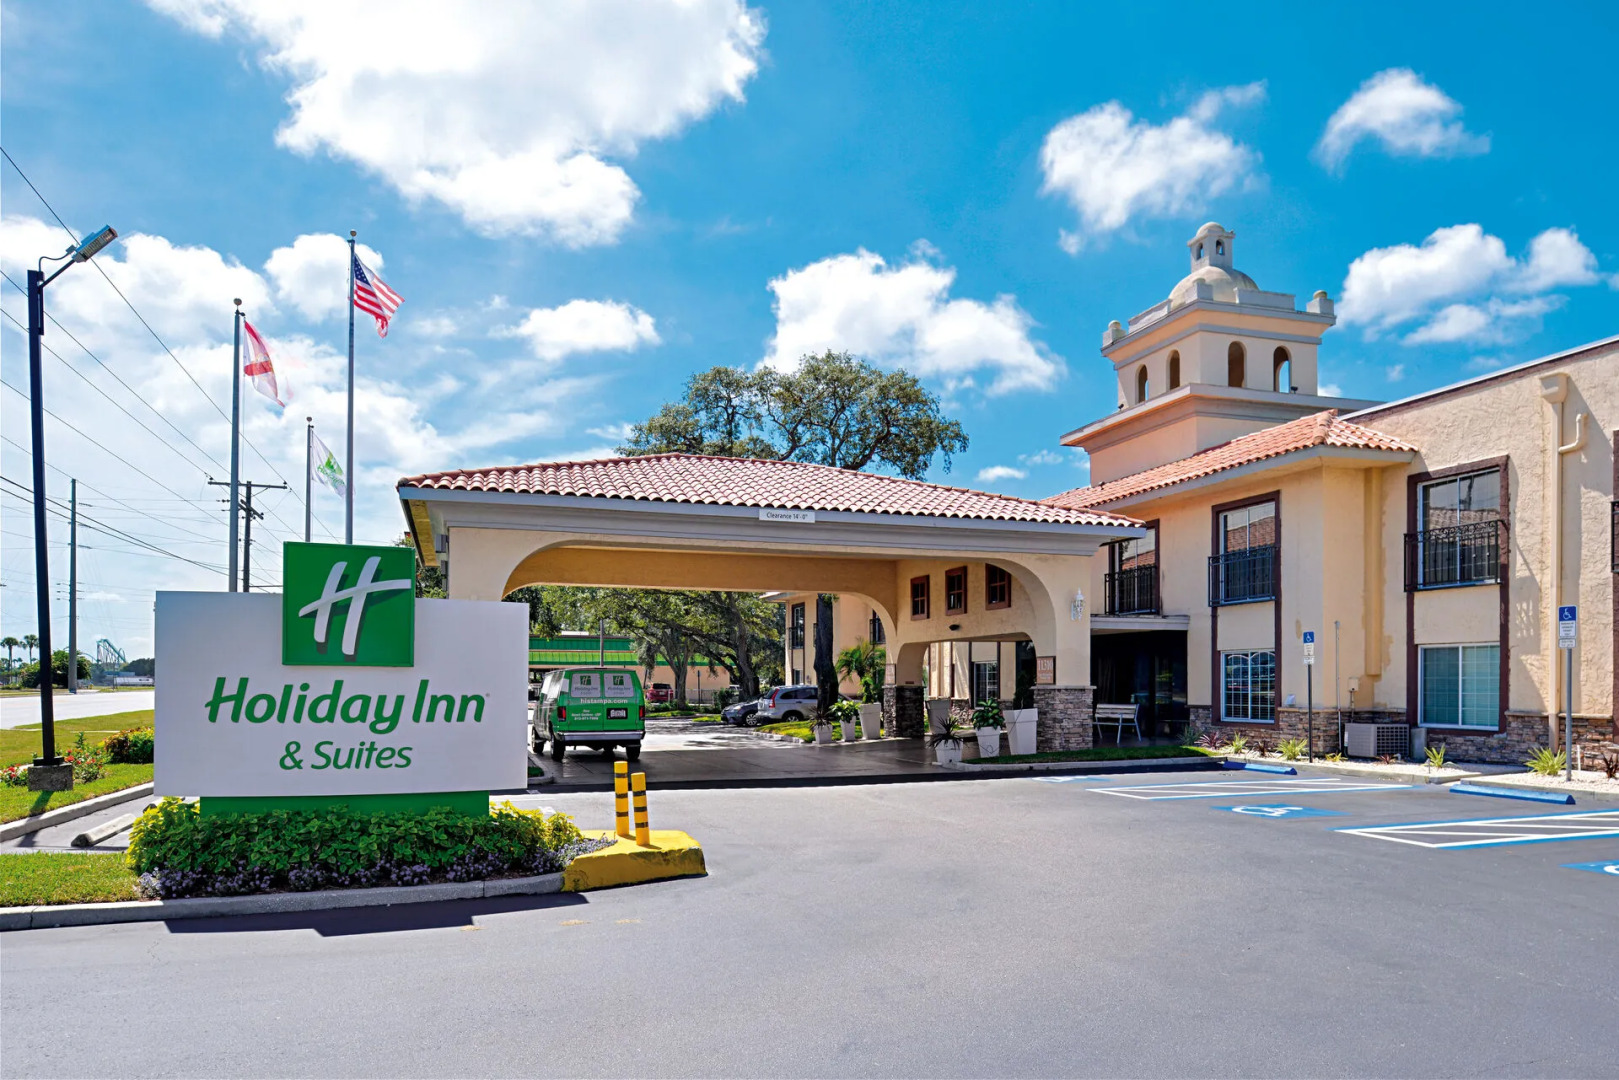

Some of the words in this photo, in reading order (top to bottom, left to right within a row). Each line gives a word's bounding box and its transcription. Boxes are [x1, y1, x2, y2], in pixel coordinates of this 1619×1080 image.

[766, 511, 792, 520] Clearance
[298, 556, 411, 656] H
[205, 677, 404, 734] Holiday
[413, 679, 485, 723] Inn
[279, 741, 303, 769] &
[311, 741, 412, 769] Suites
